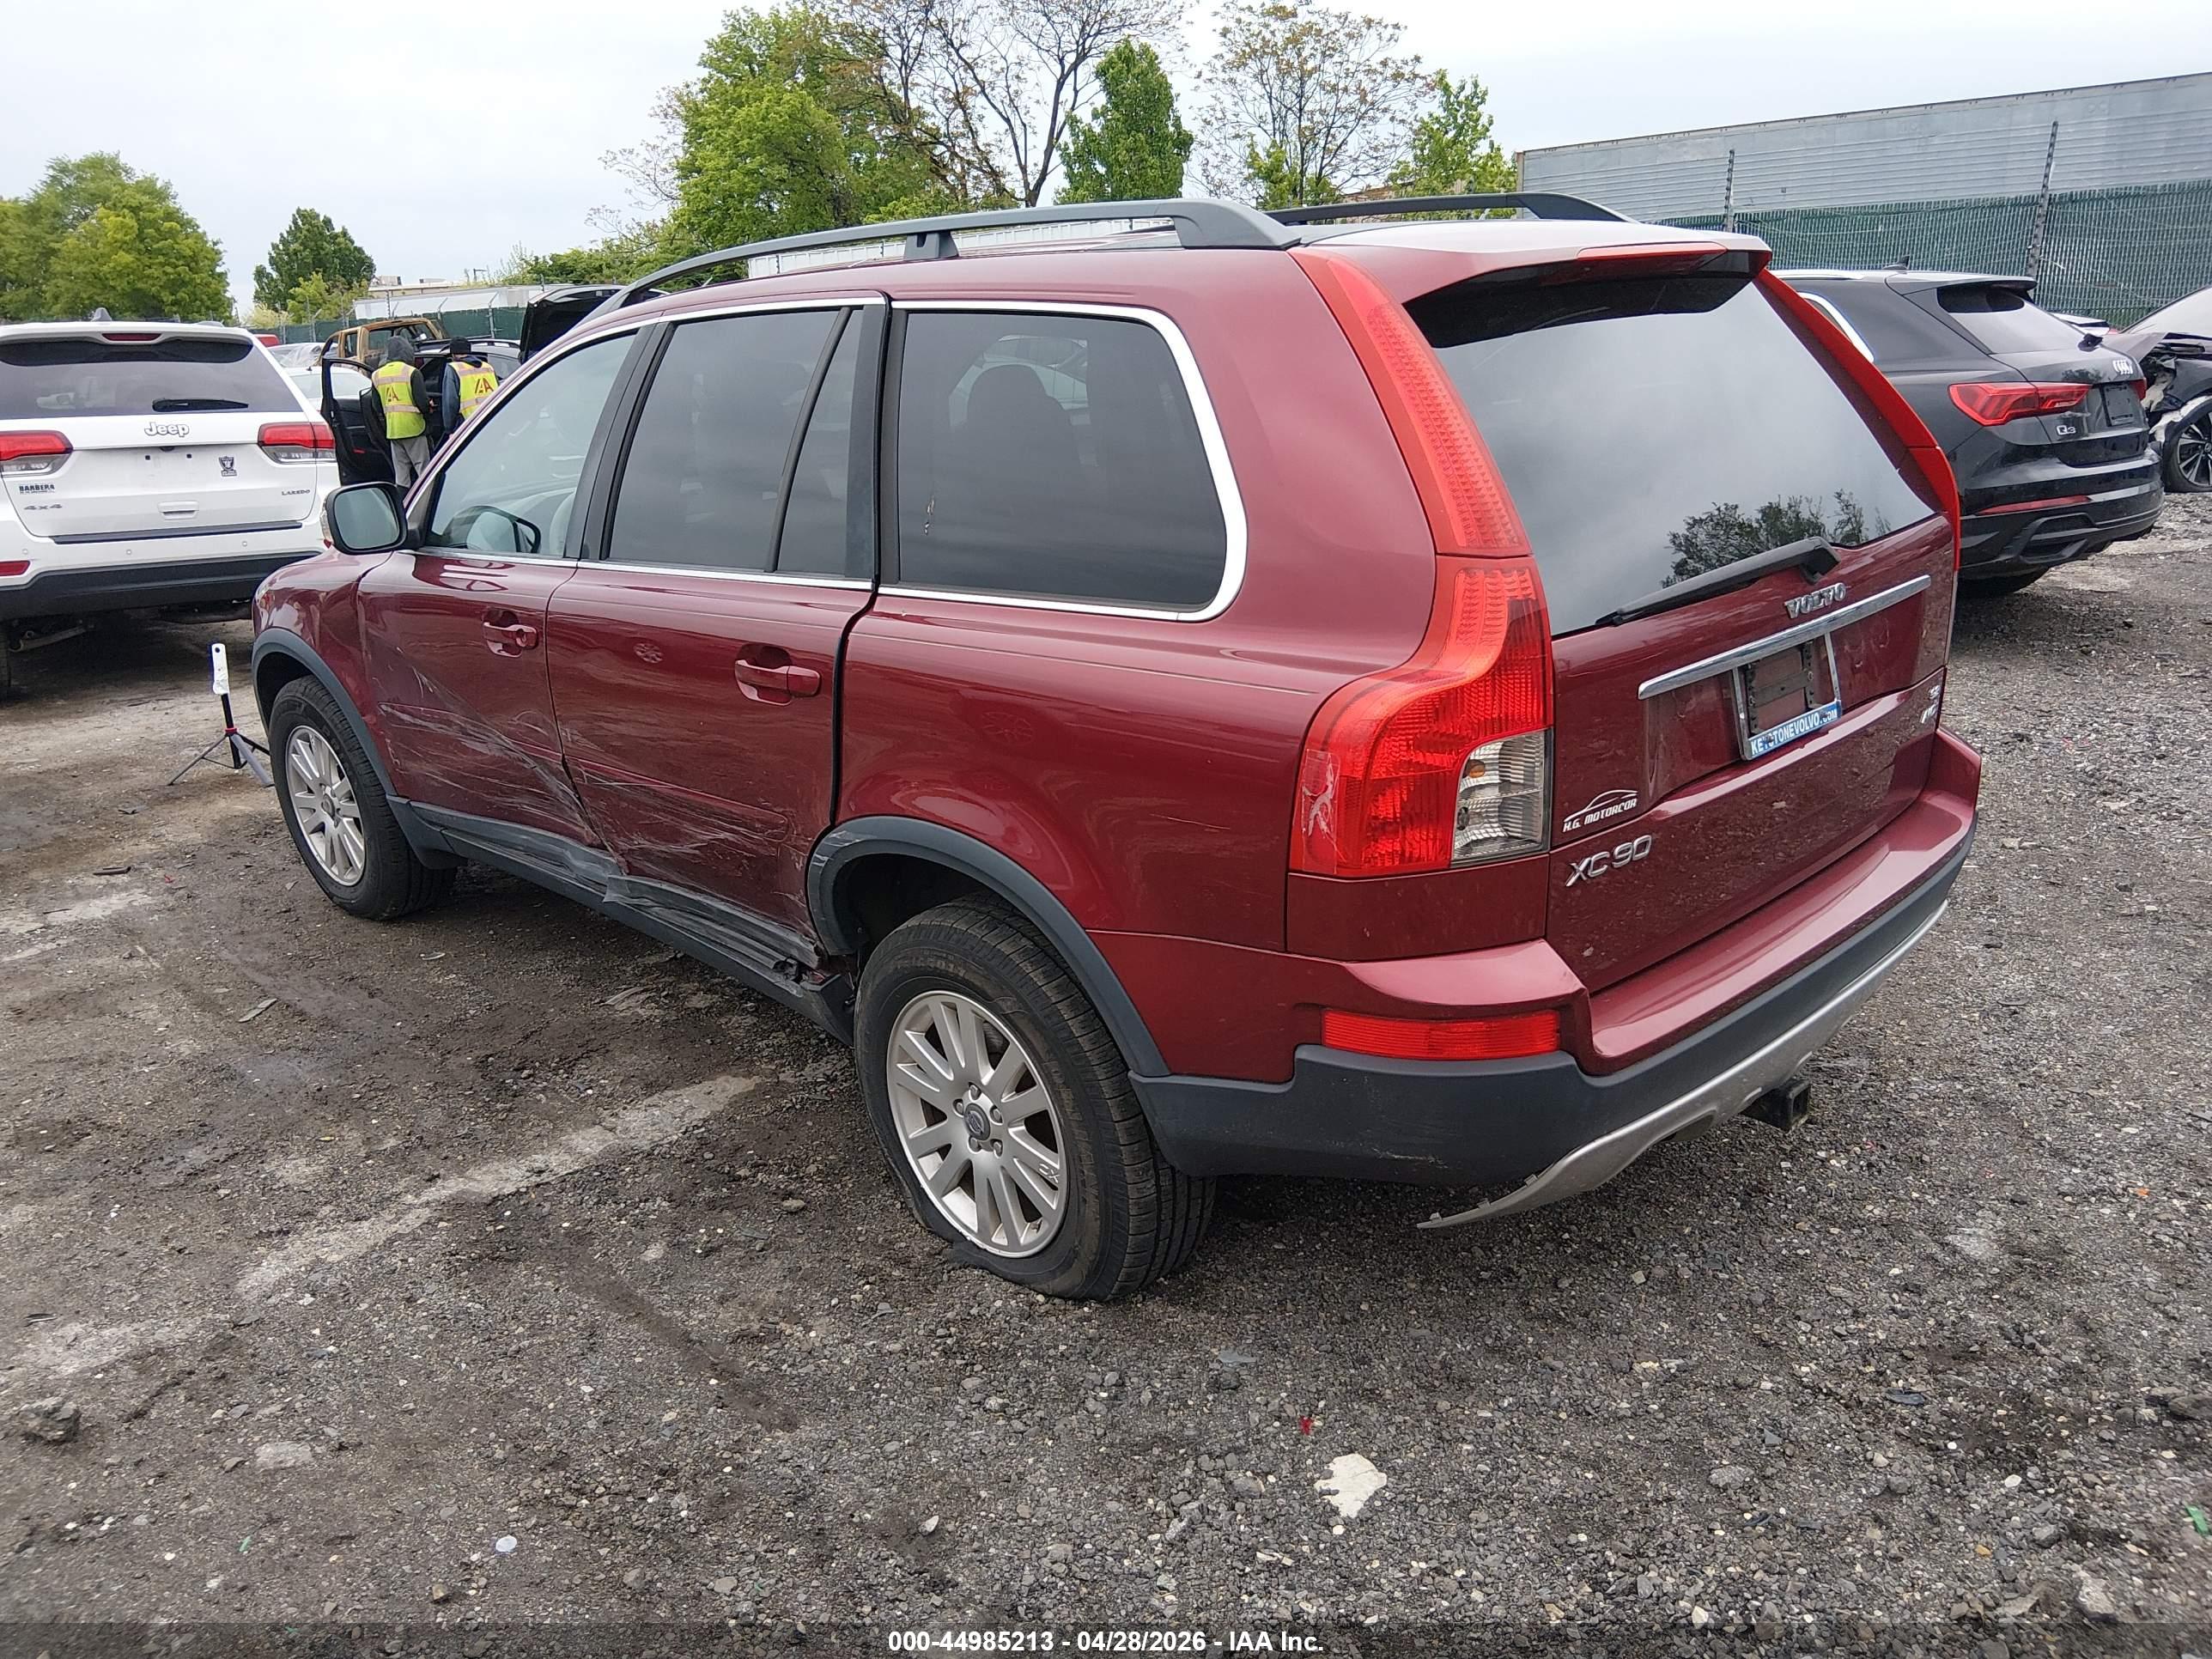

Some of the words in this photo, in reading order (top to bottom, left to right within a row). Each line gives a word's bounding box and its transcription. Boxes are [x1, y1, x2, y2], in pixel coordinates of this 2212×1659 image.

[143, 421, 190, 438] Jeep
[2056, 424, 2076, 435] Q3
[1784, 582, 1846, 619] VOLVO
[1565, 834, 1652, 887] XC90
